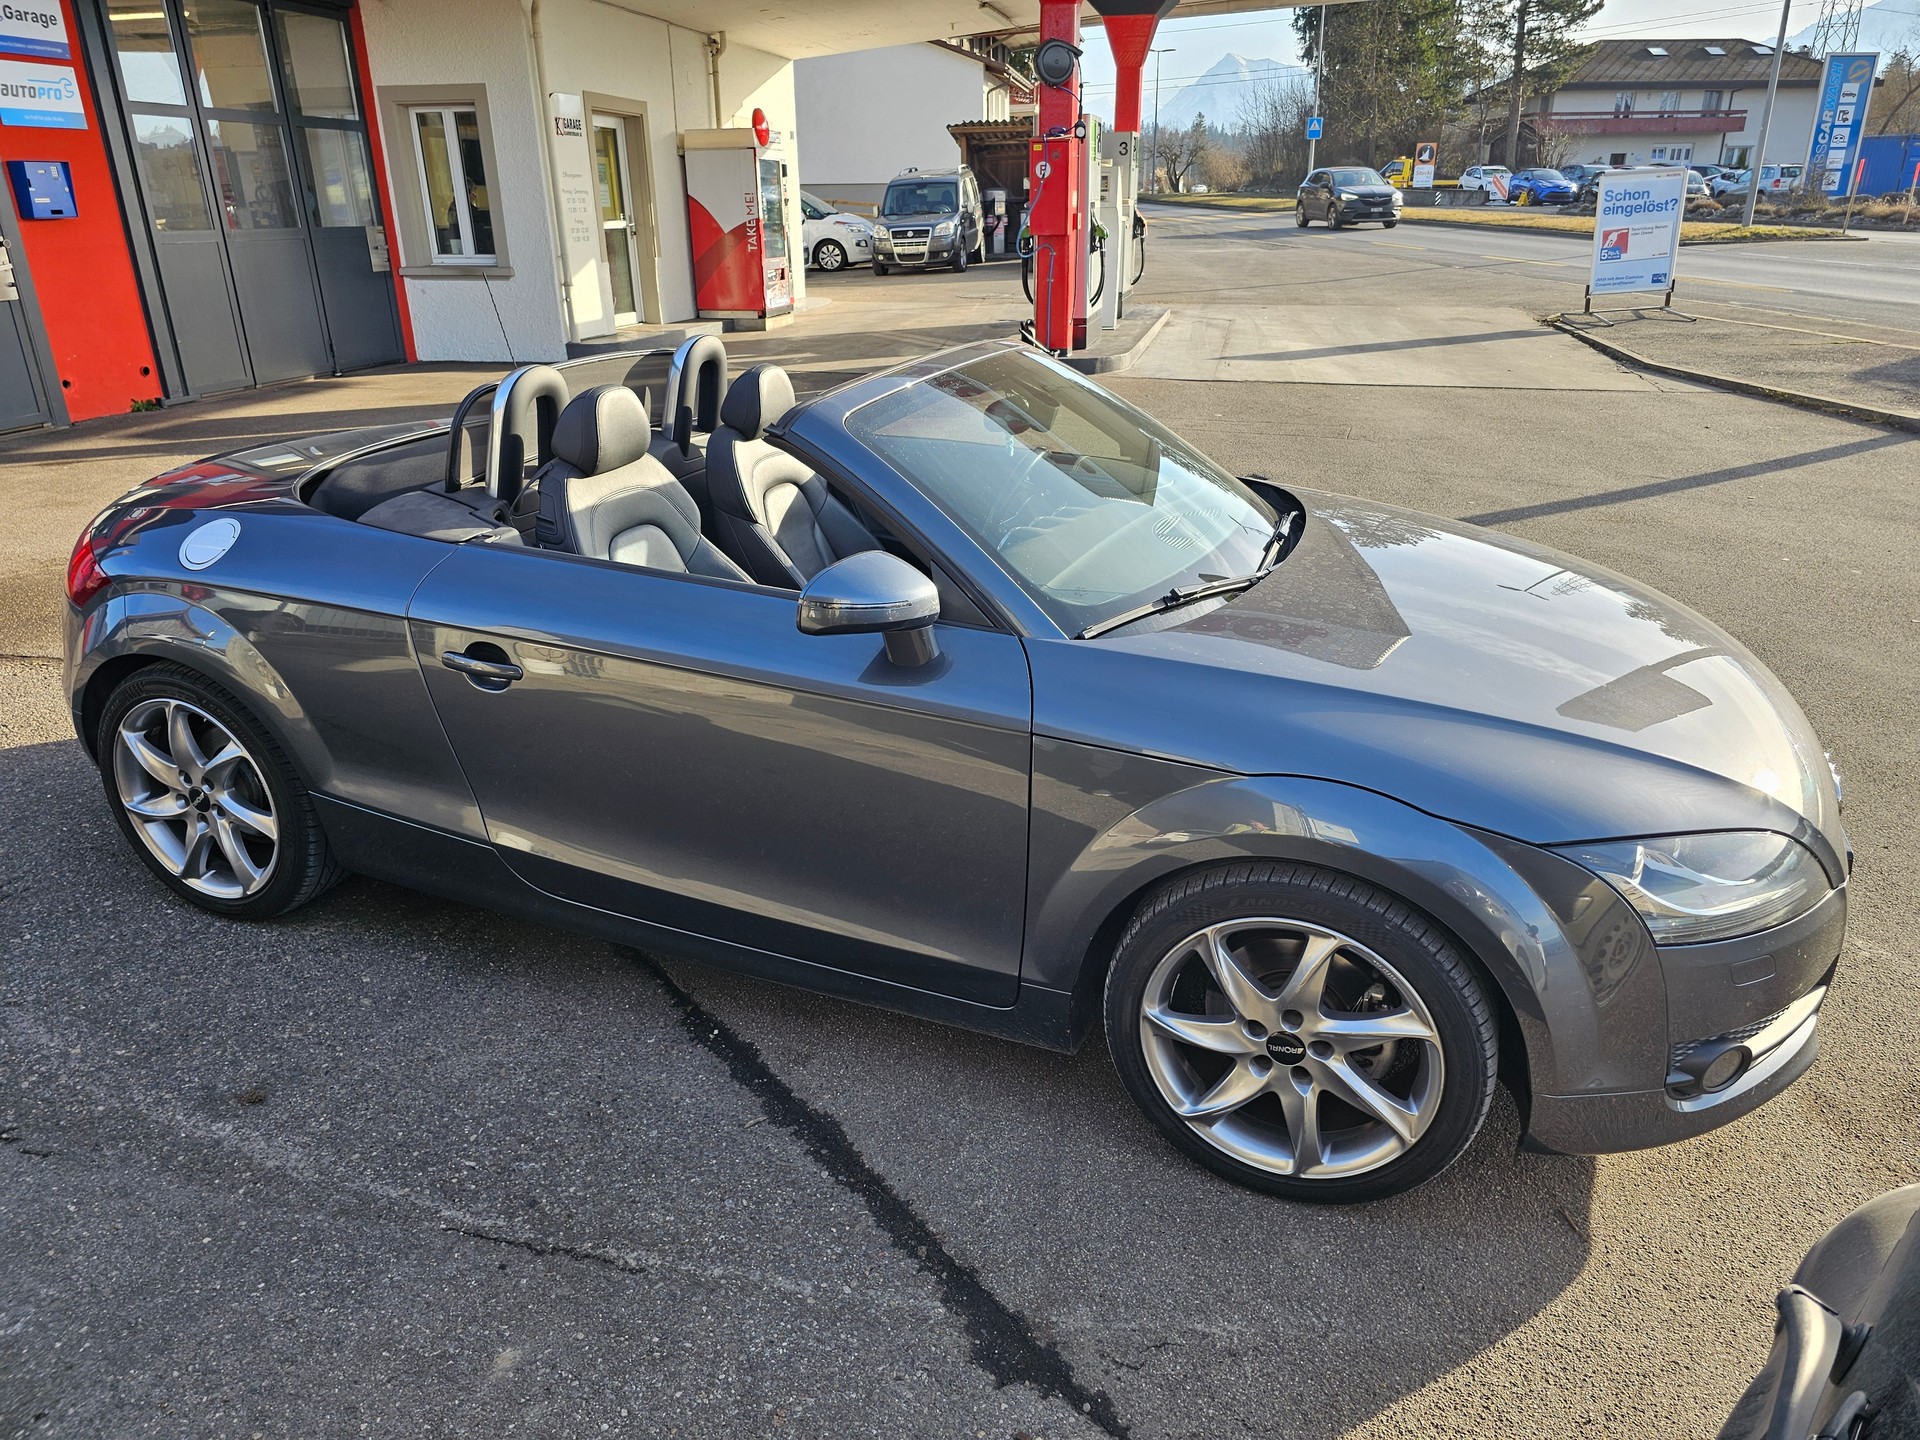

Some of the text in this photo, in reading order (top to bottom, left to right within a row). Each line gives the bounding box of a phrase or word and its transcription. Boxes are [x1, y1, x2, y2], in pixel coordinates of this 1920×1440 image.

[3, 5, 58, 28] Garage
[563, 117, 582, 131] GARAGE
[1118, 141, 1129, 156] 3
[1604, 189, 1650, 202] Schon
[1603, 198, 1678, 217] eingelöst?
[744, 192, 758, 253] TAKE ME!
[1601, 249, 1608, 260] 5
[1268, 1044, 1298, 1054] RONAL
